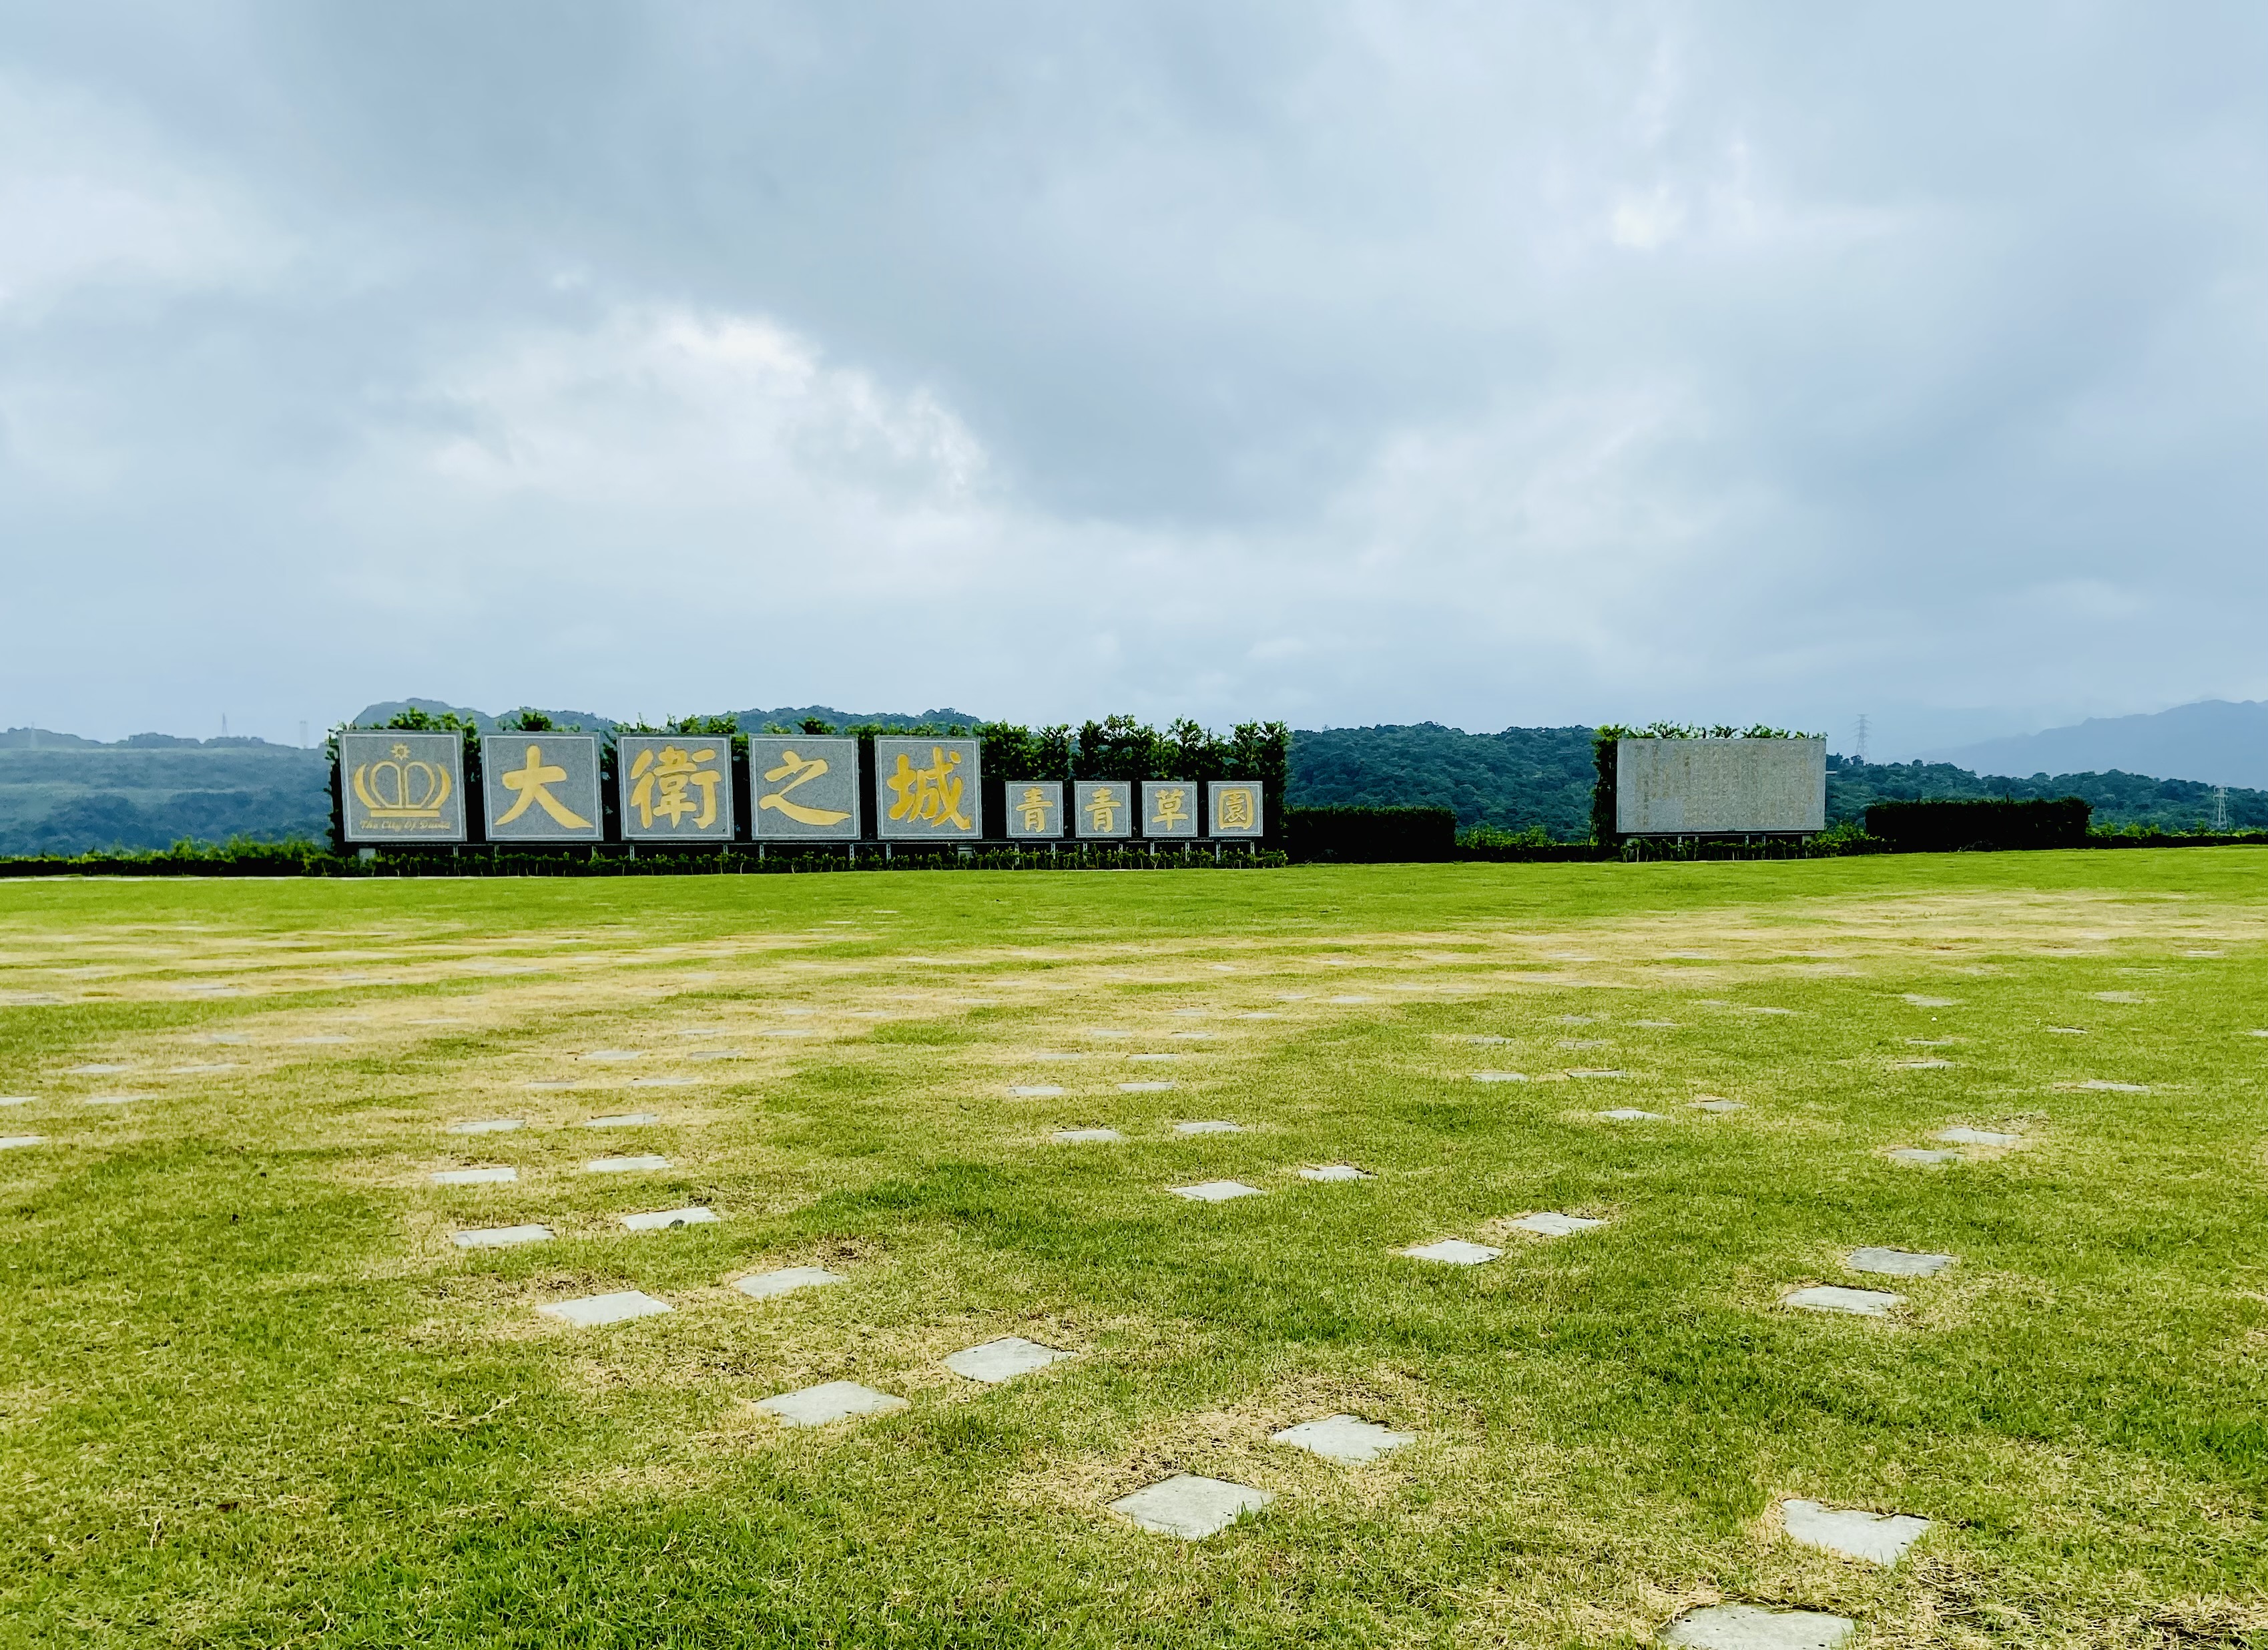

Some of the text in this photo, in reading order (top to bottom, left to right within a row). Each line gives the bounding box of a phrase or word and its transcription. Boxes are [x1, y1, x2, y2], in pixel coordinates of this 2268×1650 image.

[494, 745, 972, 831] 大衛之城
[1016, 786, 1254, 831] 青青草園
[360, 820, 378, 830] The
[381, 820, 401, 832] City
